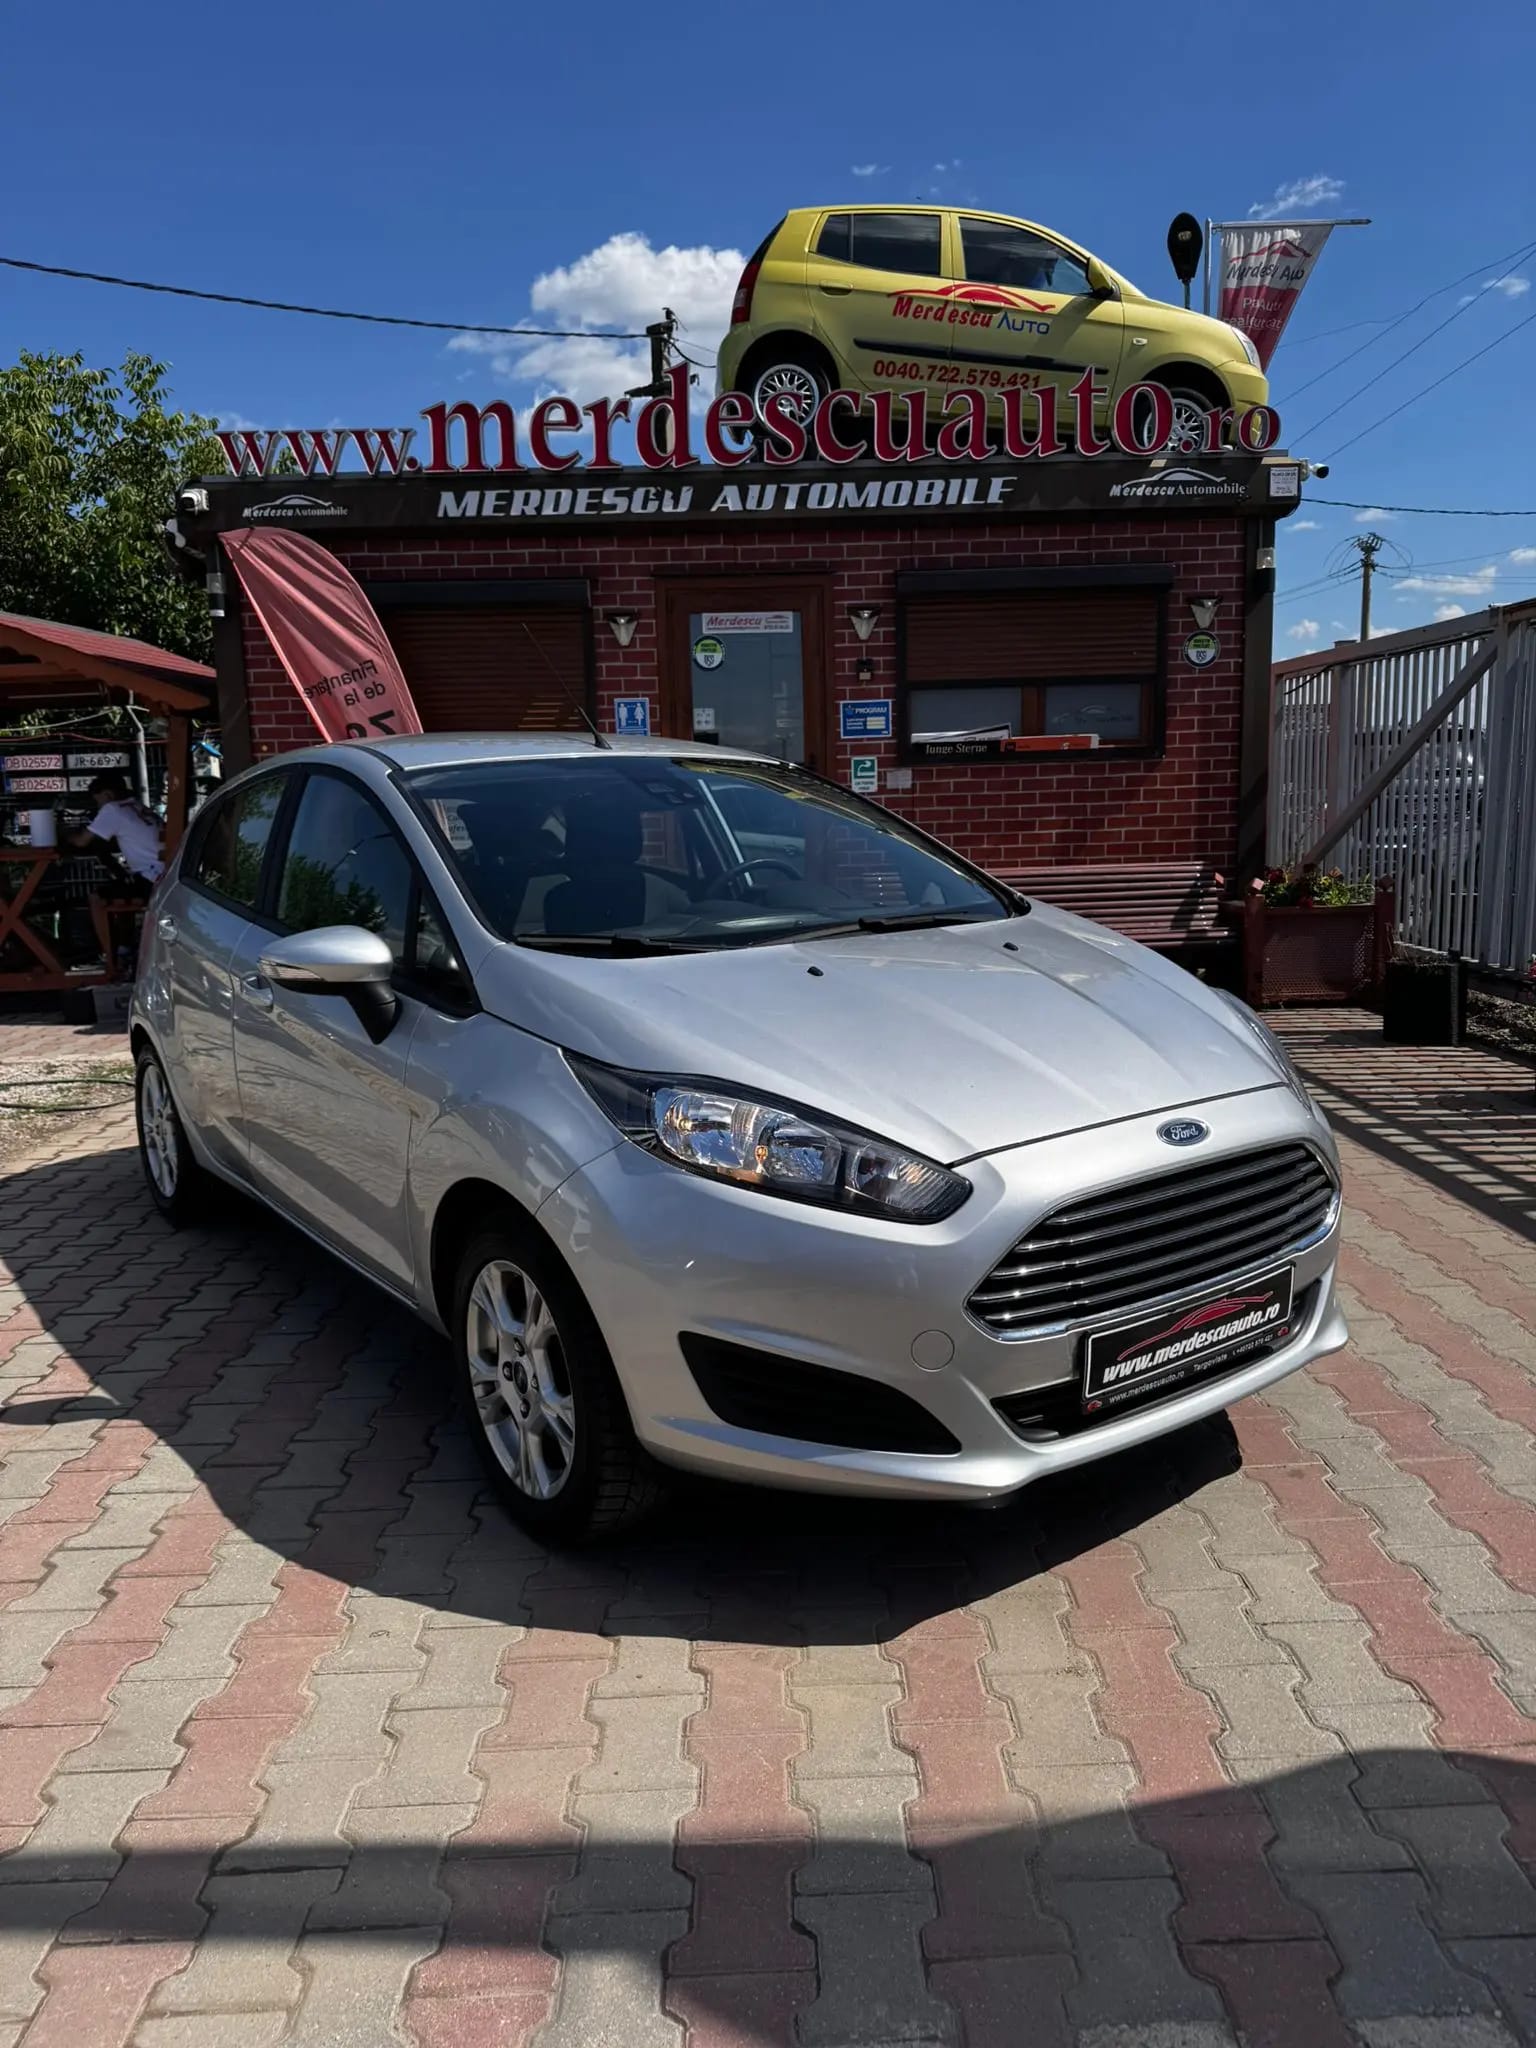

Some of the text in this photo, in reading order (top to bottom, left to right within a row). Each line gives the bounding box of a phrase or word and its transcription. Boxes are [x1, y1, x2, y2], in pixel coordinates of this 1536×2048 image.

[892, 297, 993, 328] Merdescu
[873, 359, 1041, 389] 0040.722.579.421
[214, 362, 1281, 477] www.merdescuauto.ro
[437, 476, 1018, 518] MERDESCU AUTOMOBILE
[707, 615, 762, 626] Merdescu
[926, 743, 988, 754] Junge Sterne
[1170, 1124, 1199, 1141] Ford
[1102, 1302, 1280, 1384] www.merdescuauto.ro
[1109, 1371, 1185, 1403] www.merdescuauto.ro
